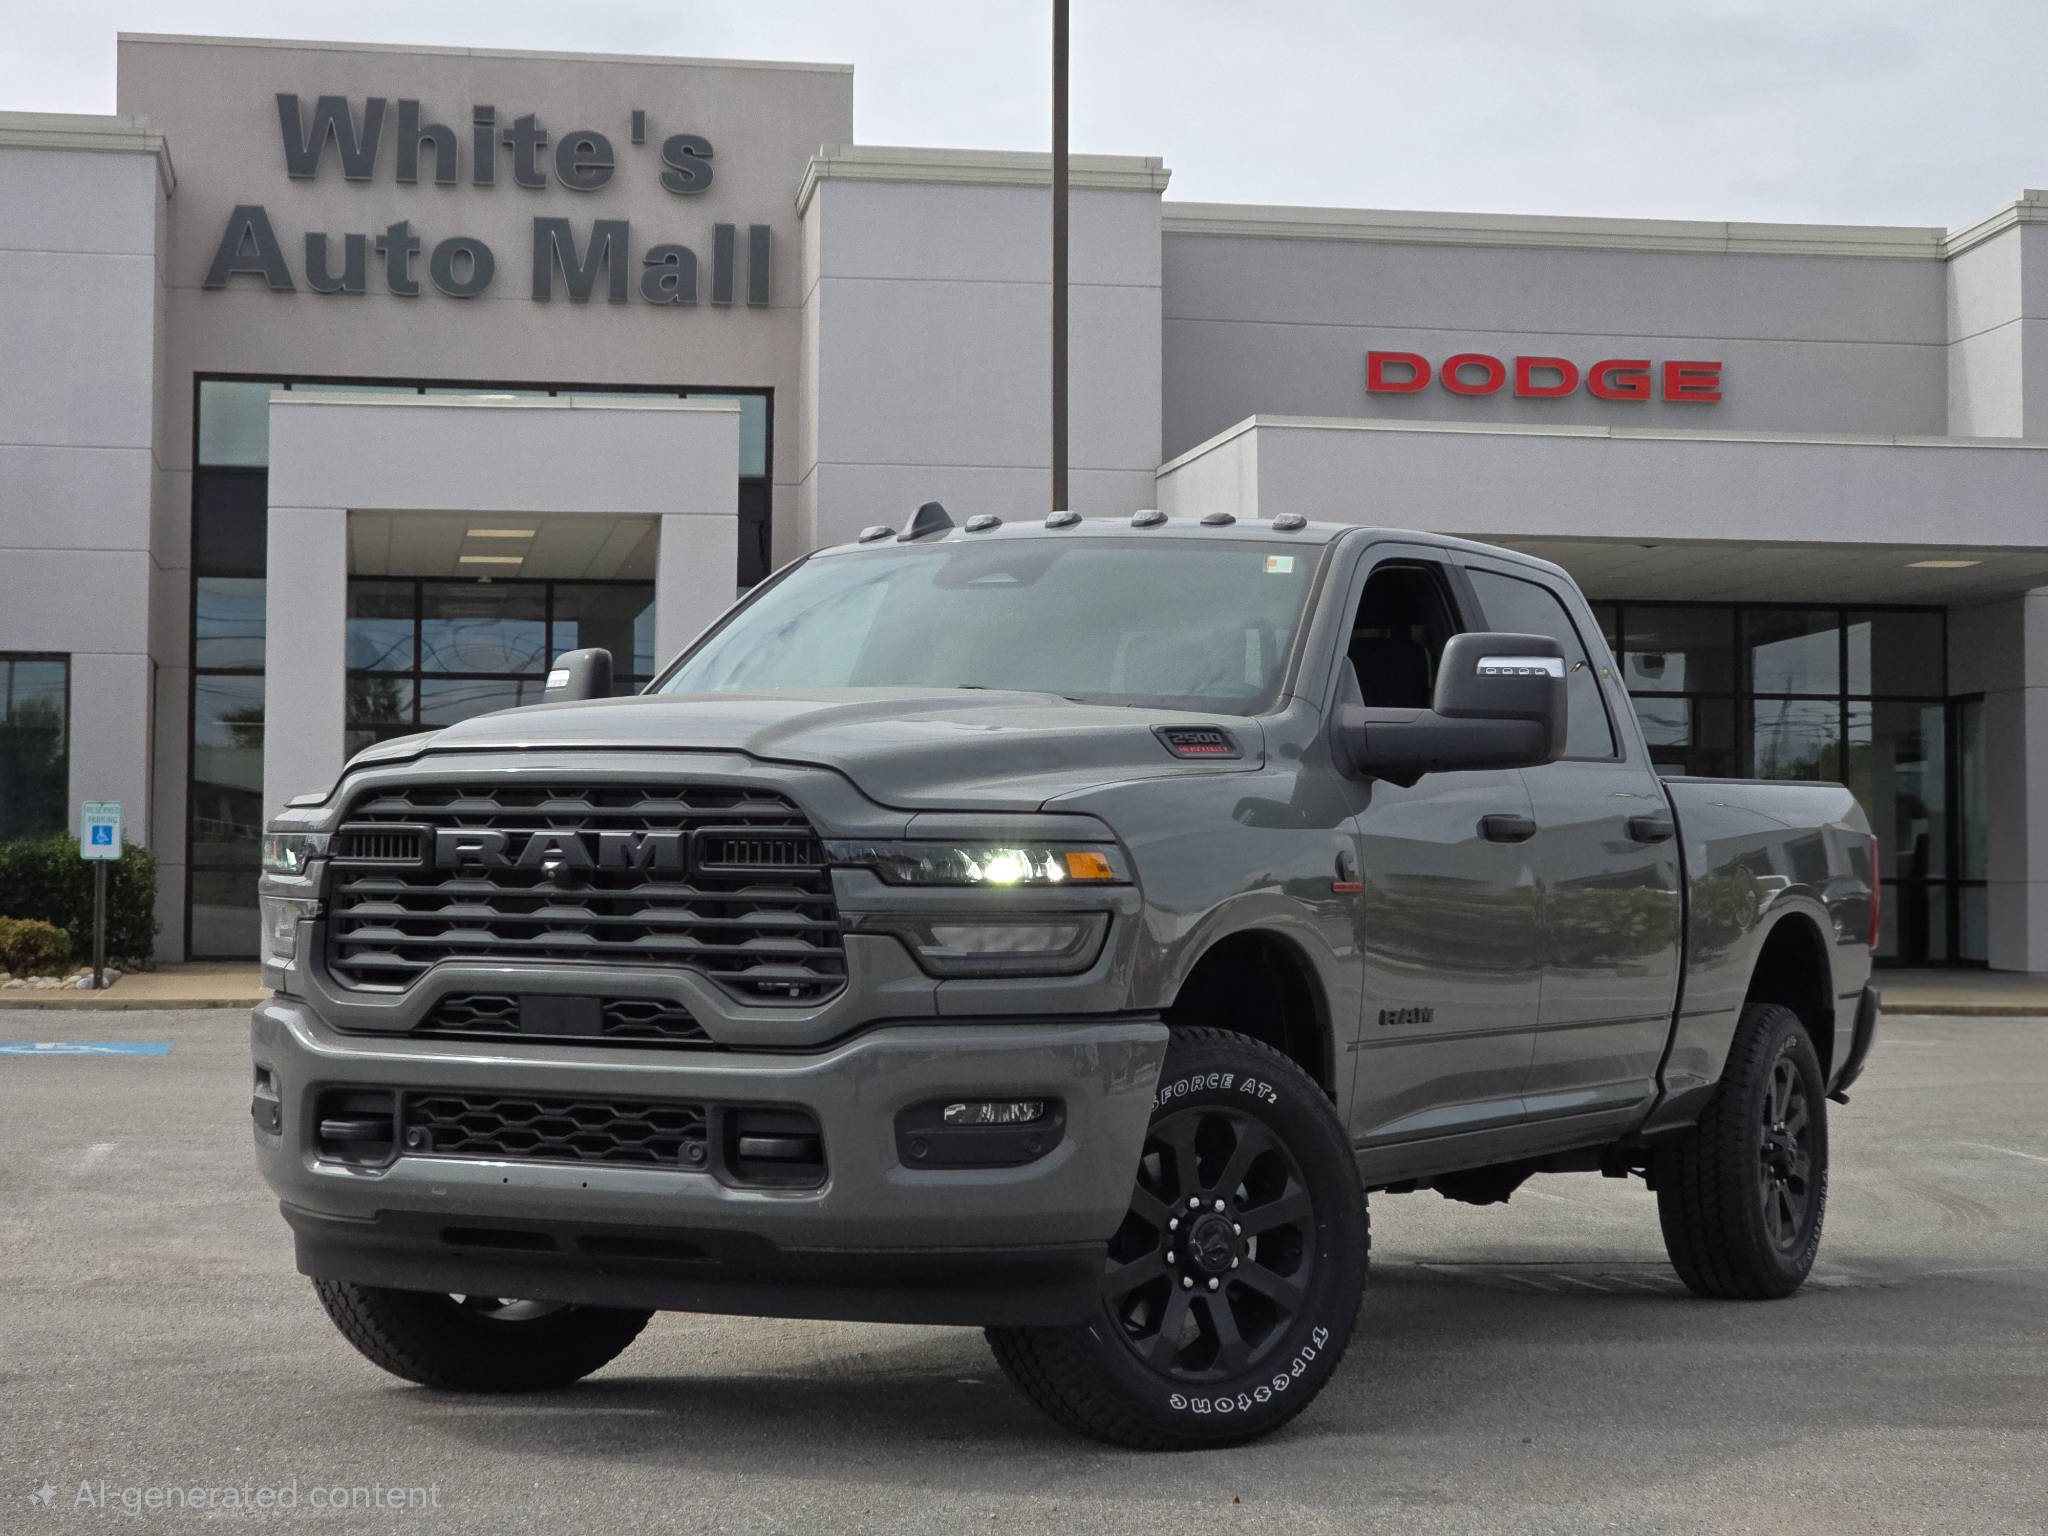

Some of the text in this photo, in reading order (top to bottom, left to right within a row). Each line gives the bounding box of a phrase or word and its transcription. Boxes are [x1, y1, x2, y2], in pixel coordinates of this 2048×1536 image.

[275, 93, 715, 194] White's
[202, 204, 772, 306] Auto Mall
[1366, 350, 1723, 403] DODGE
[1171, 732, 1223, 744] 2500
[84, 806, 120, 814] RESERVED
[88, 815, 118, 824] PARKING
[436, 829, 686, 871] RAM
[1378, 1007, 1435, 1026] RAM
[1169, 1326, 1329, 1414] Firestone
